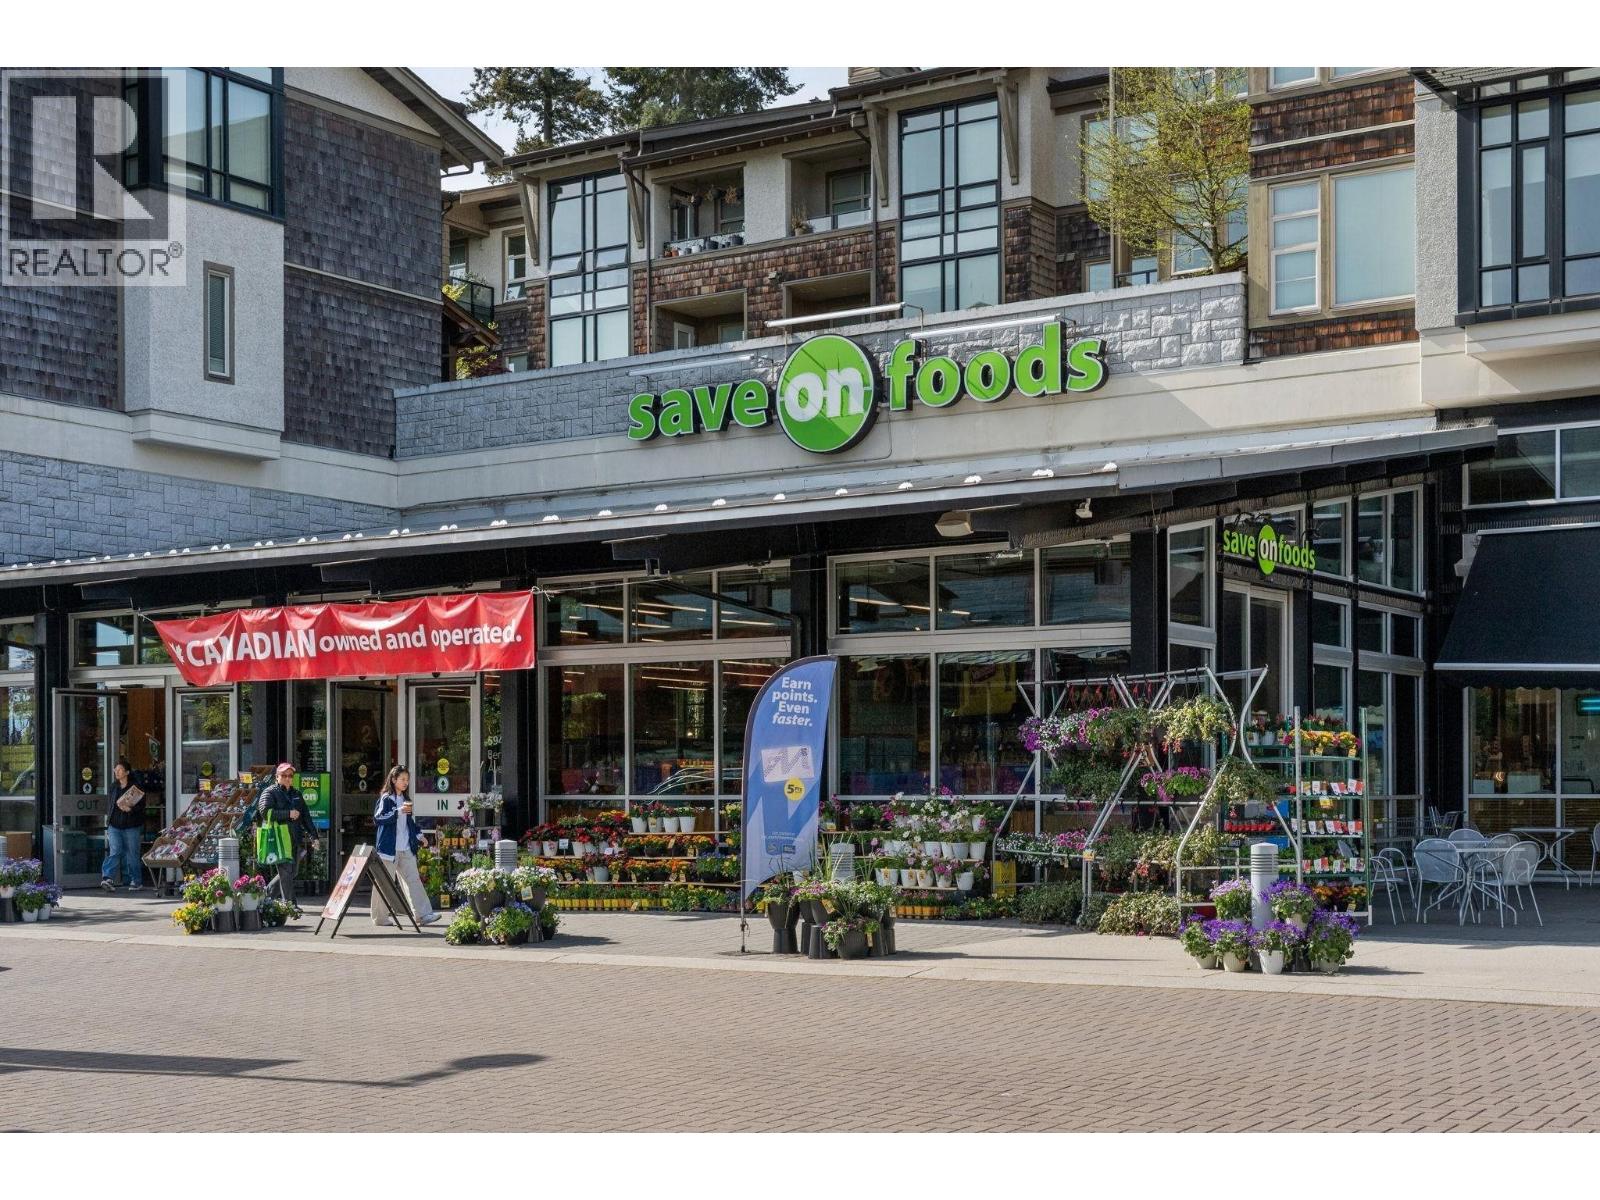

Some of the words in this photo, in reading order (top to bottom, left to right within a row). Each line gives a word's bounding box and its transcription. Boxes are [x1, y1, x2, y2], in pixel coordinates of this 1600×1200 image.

[627, 378, 772, 442] save
[783, 367, 865, 422] on
[886, 322, 1108, 411] foods
[1223, 529, 1255, 557] save
[1260, 538, 1278, 562] on
[1278, 534, 1316, 570] foods
[186, 629, 317, 667] CANADIAN
[319, 629, 383, 652] owned
[386, 624, 427, 650] and
[431, 619, 522, 652] operated.
[781, 676, 812, 690] Earn
[771, 689, 818, 703] points.
[778, 701, 810, 714] Even
[772, 712, 813, 727] faster.
[303, 793, 317, 801] on
[77, 800, 99, 809] OUT
[437, 799, 449, 811] IN
